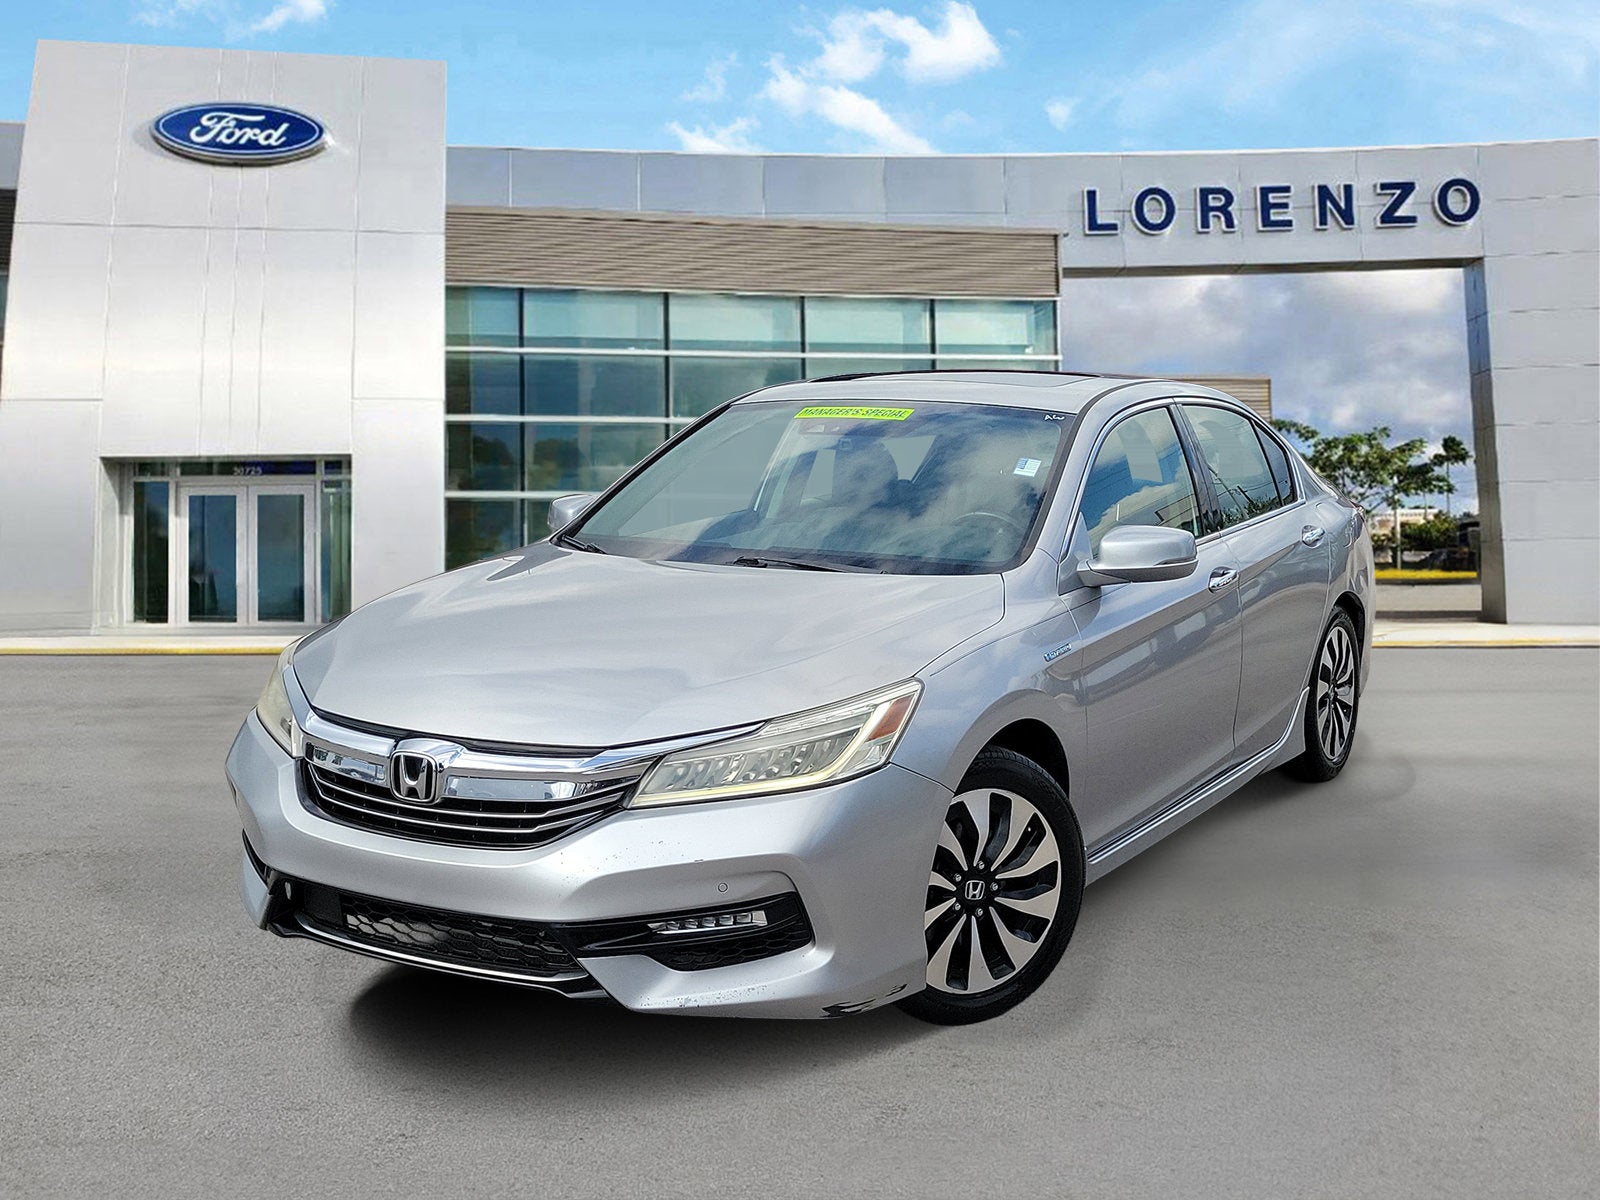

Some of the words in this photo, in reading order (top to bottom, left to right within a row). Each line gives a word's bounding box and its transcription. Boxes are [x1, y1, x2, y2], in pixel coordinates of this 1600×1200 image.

[189, 111, 290, 147] Ford
[1083, 178, 1481, 236] LORENZO
[804, 408, 861, 416] MANAGER'S
[861, 409, 906, 418] SPECIAL
